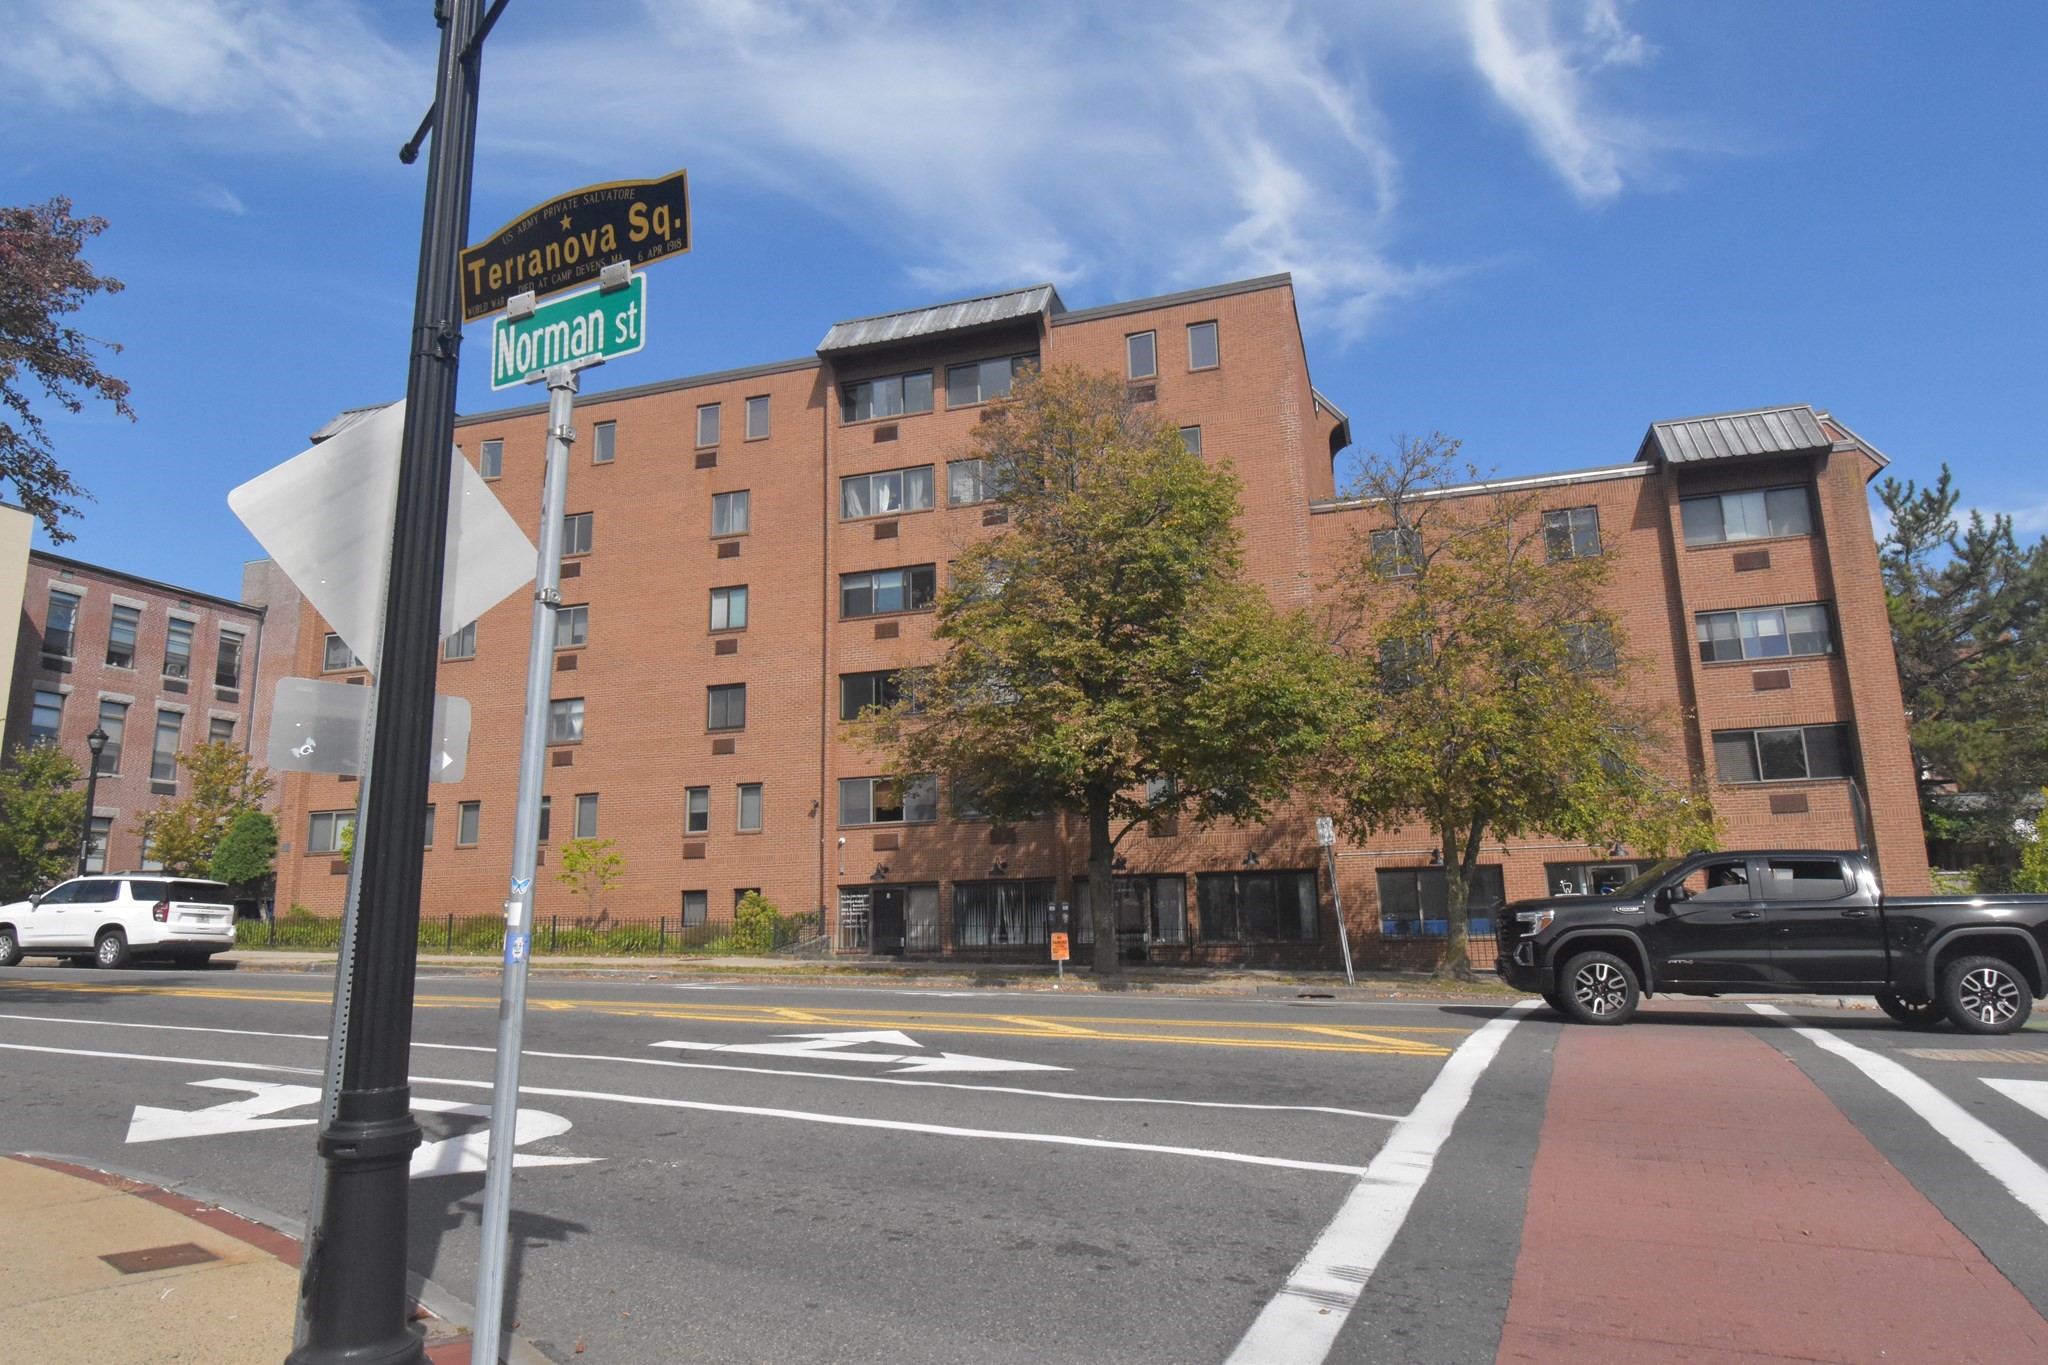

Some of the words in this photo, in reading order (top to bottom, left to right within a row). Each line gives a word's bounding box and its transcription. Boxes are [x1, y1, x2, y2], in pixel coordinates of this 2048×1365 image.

[468, 223, 617, 295] Terranova
[628, 201, 681, 242] Sq.
[502, 231, 514, 245] US
[518, 214, 539, 236] ARMY
[543, 196, 579, 220] PRIVATE
[583, 188, 636, 205] SALVATORE
[467, 302, 488, 317] WORLD
[491, 297, 505, 307] WAR
[538, 275, 548, 287] AT
[551, 269, 573, 285] CAMP
[638, 250, 644, 262] 6
[647, 244, 663, 259] APR
[666, 238, 682, 252] 1918
[498, 309, 605, 379] Norman
[615, 300, 638, 344] st
